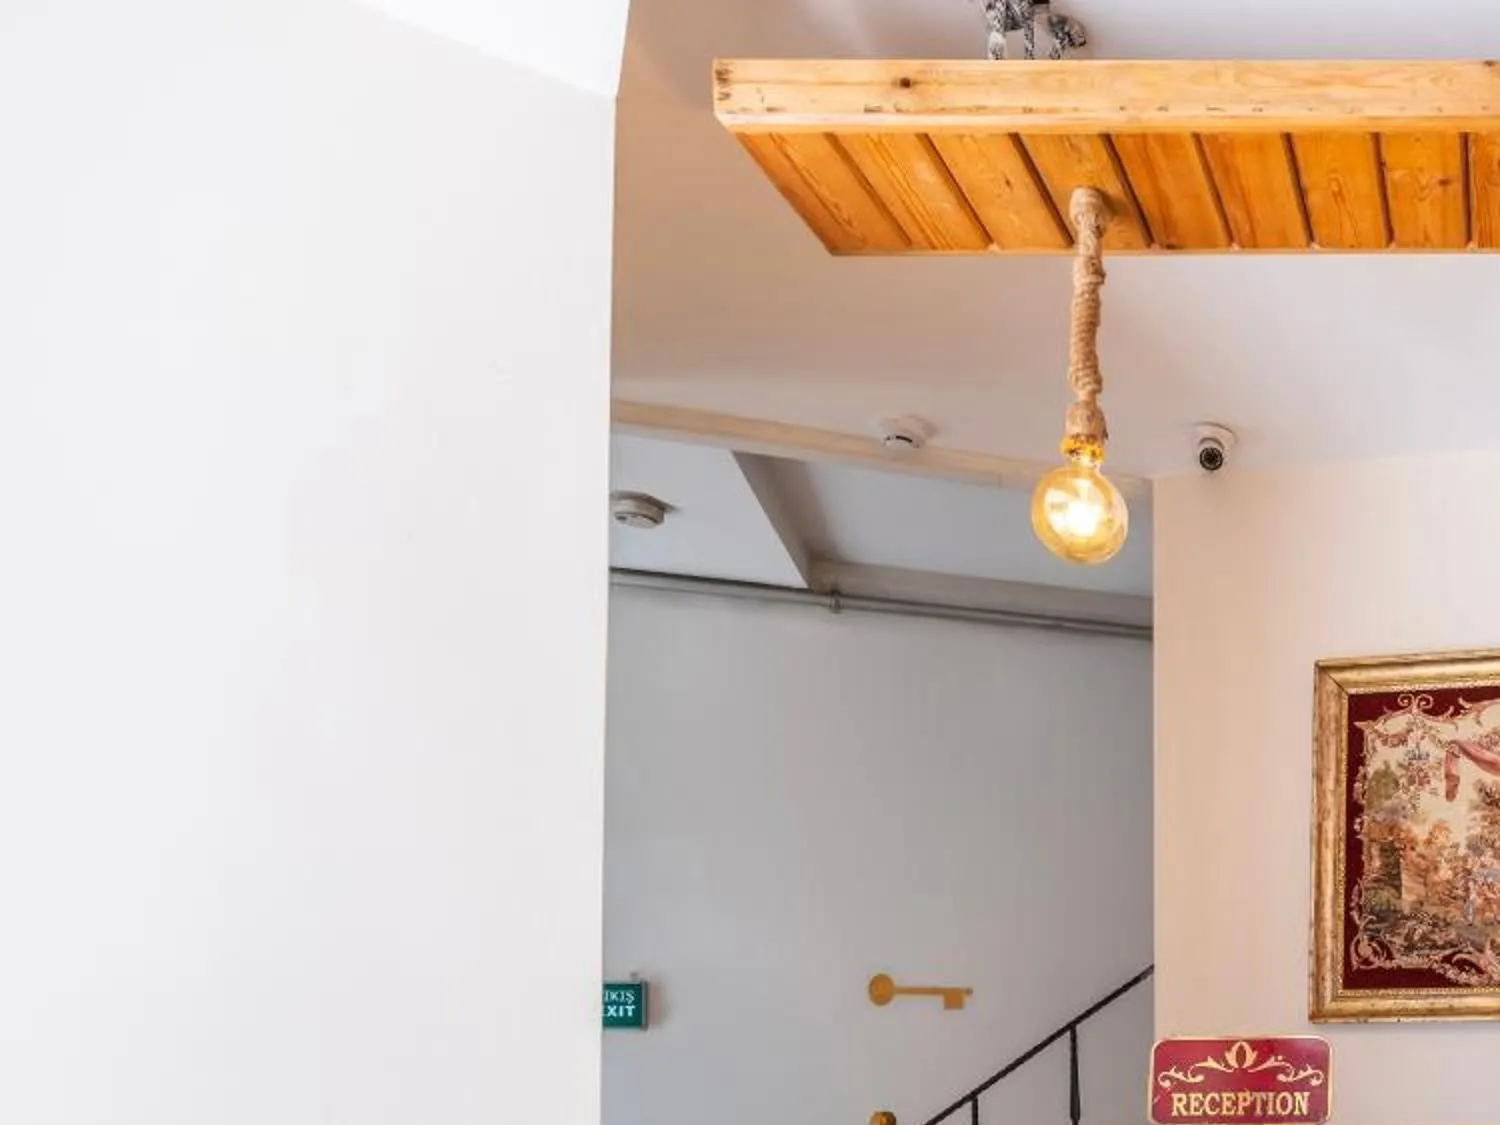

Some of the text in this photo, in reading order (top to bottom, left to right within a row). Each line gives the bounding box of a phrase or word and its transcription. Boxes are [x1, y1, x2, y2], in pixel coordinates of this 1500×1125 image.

[604, 991, 635, 1004] IKIŞ
[604, 1005, 636, 1017] XIT
[1171, 1091, 1311, 1117] RECEPTION
